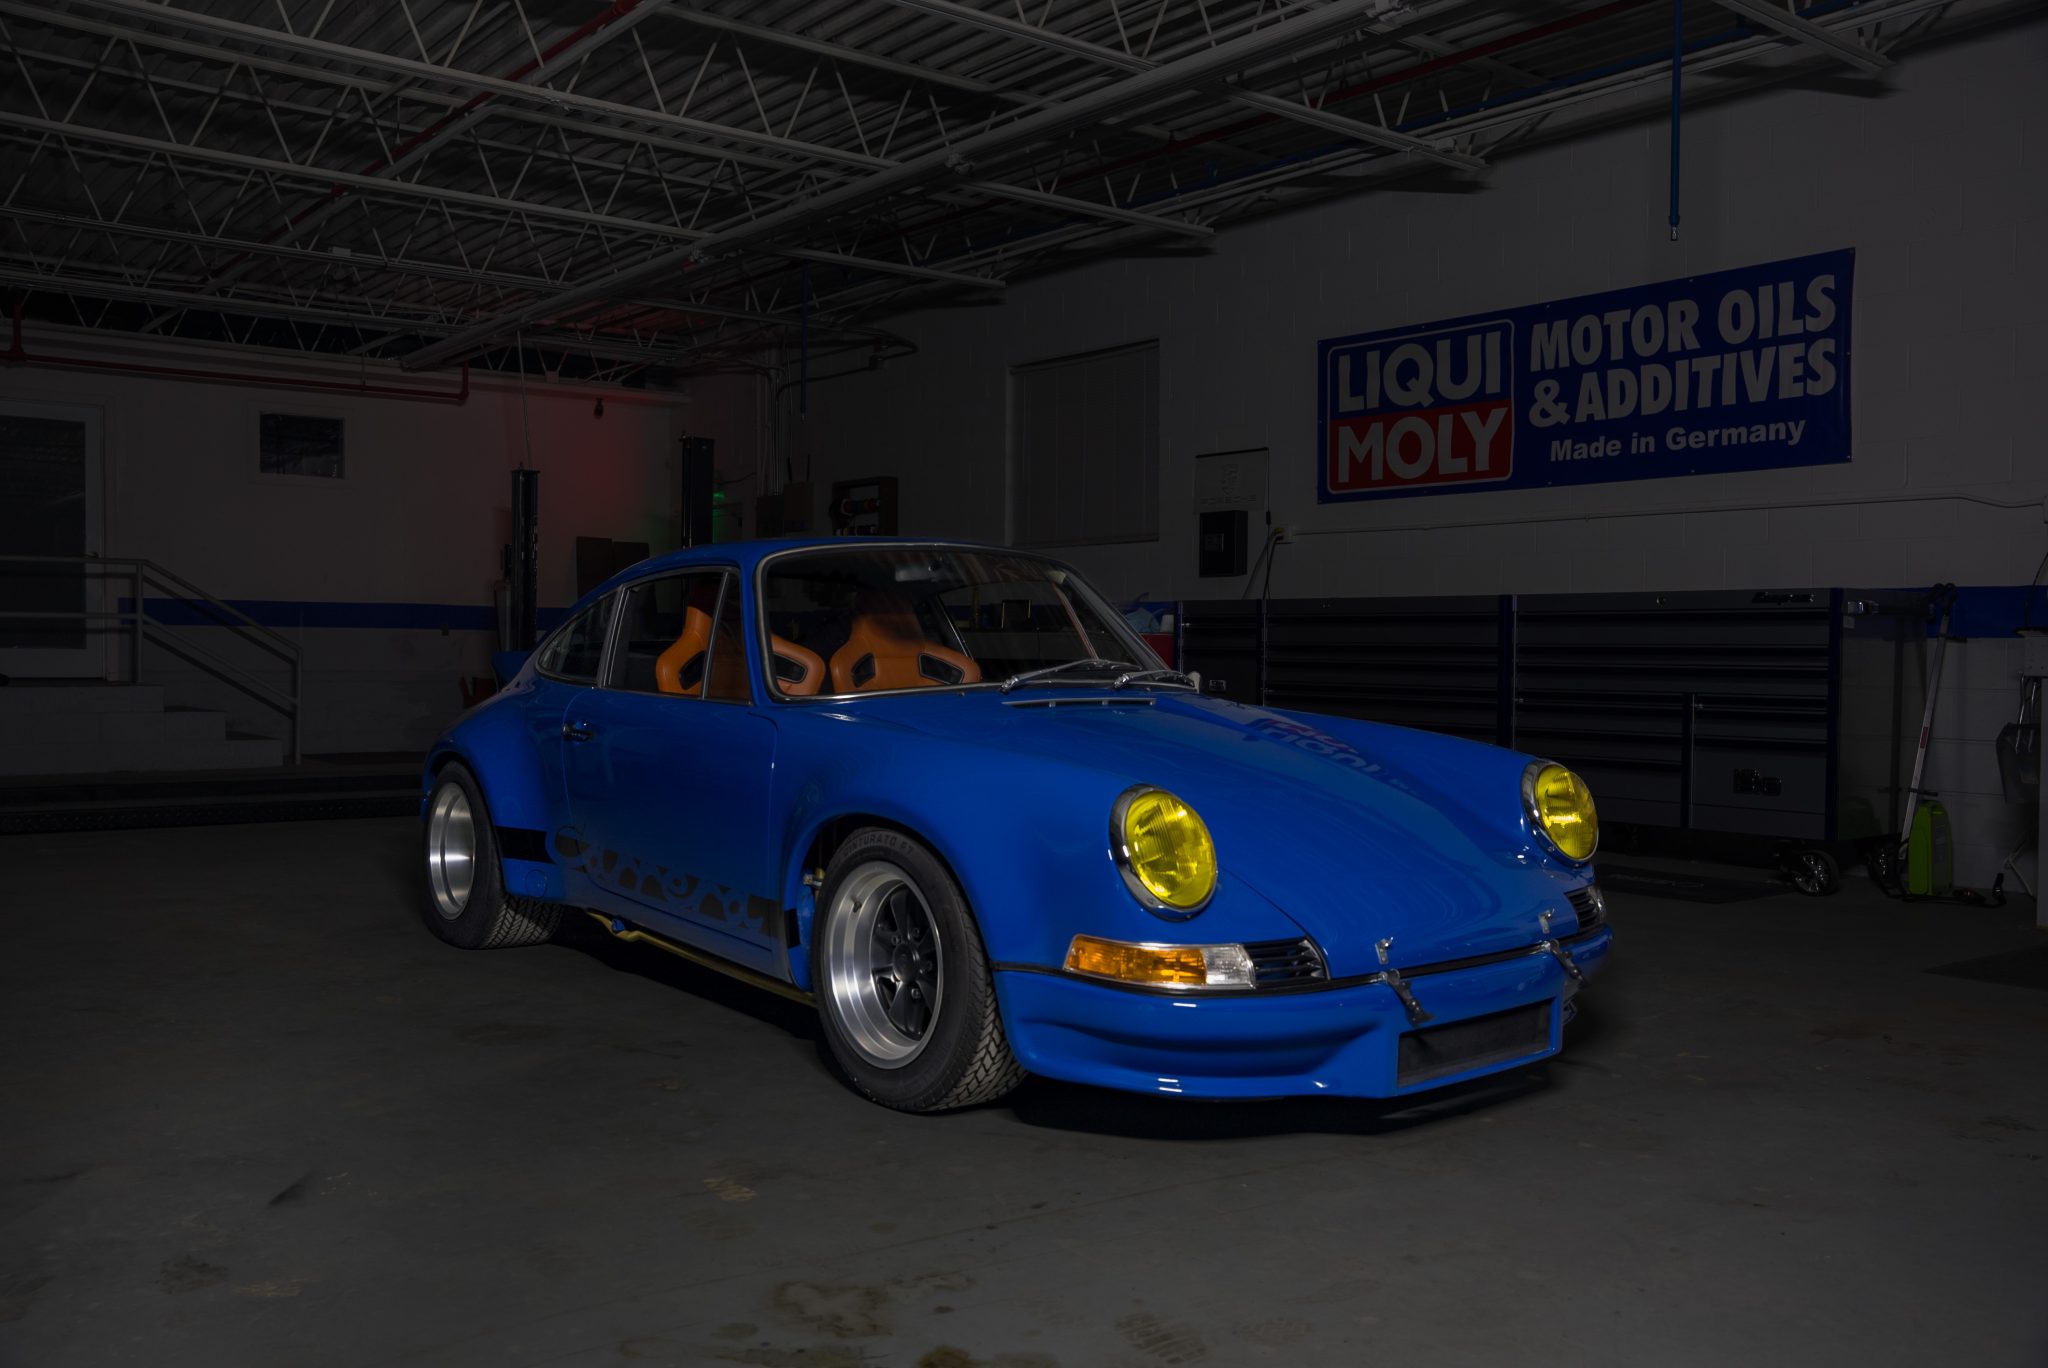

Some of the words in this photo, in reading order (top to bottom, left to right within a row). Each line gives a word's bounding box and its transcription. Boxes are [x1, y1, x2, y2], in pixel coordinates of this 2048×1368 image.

[1530, 300, 1701, 372] MOTOR
[1717, 274, 1836, 345] OILS
[1338, 331, 1501, 412] LIQUI
[1338, 407, 1508, 483] MOLY
[1550, 436, 1622, 462] Made
[1631, 433, 1655, 454] in
[1665, 420, 1806, 450] Germany
